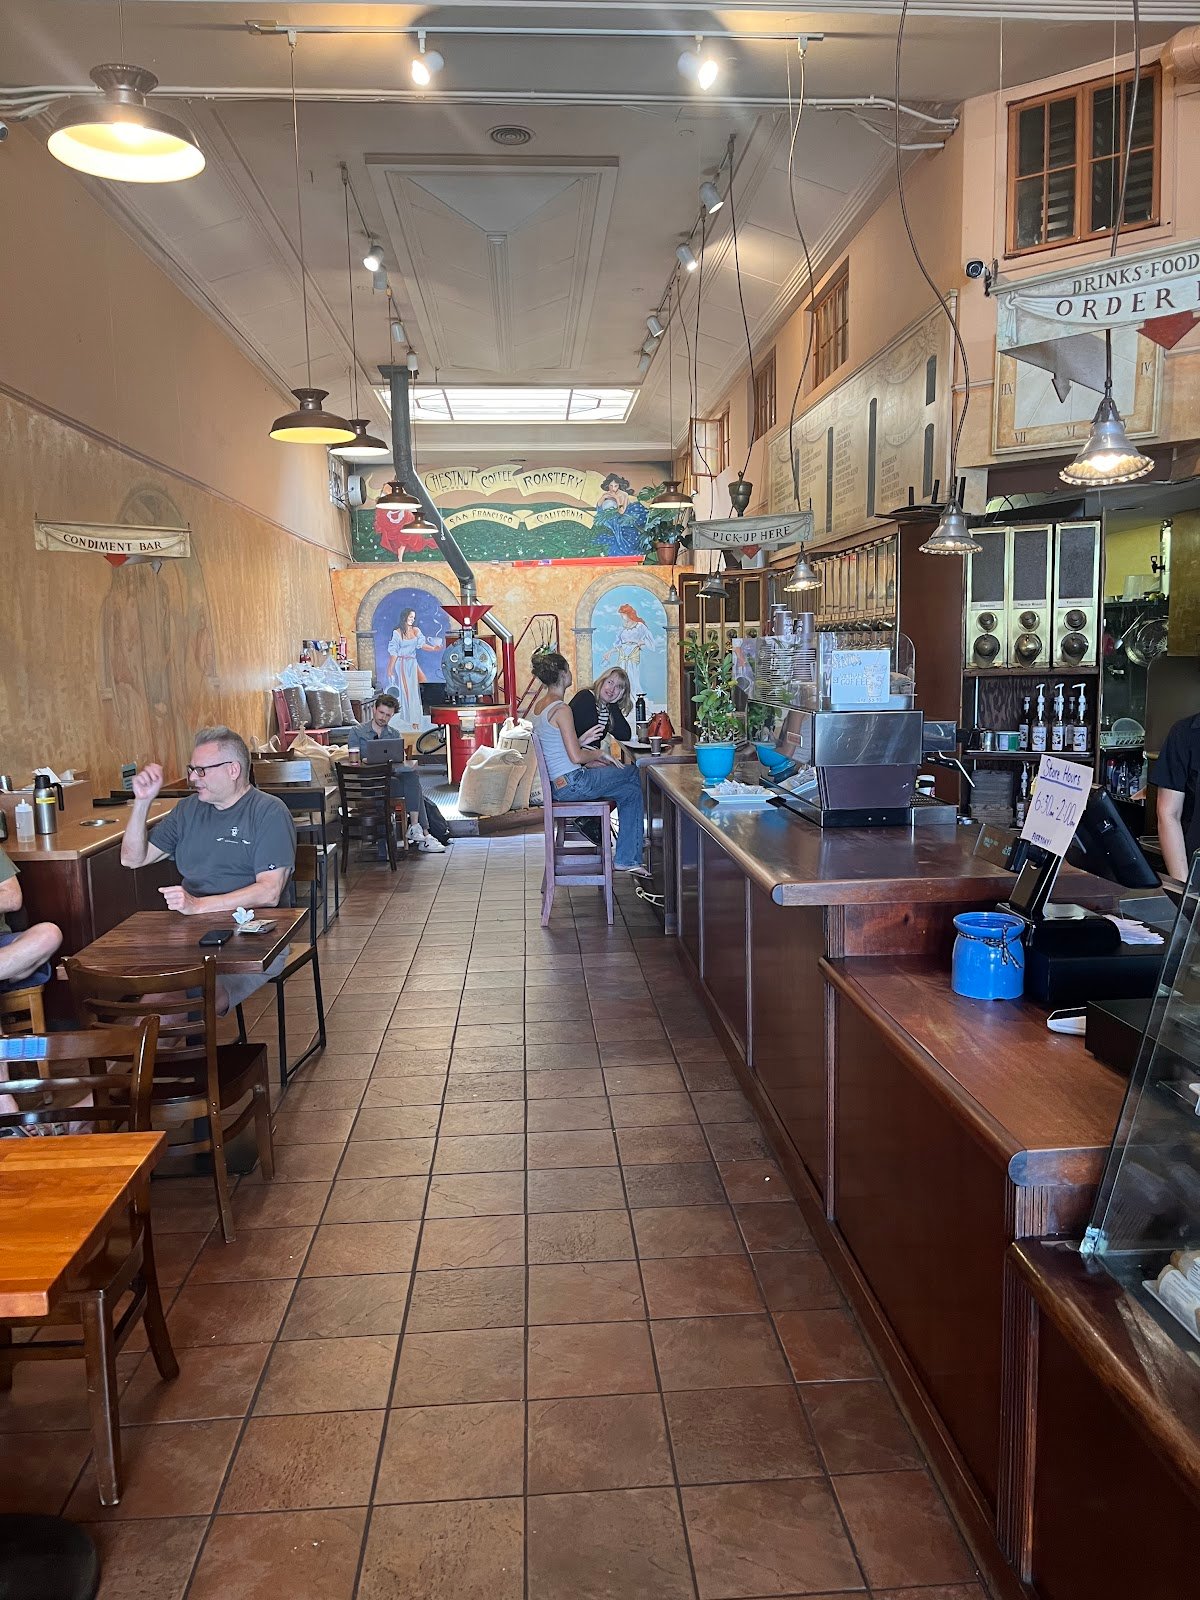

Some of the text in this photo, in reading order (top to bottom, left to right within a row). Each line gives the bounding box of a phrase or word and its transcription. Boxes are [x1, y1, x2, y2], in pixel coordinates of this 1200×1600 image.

[1072, 253, 1200, 295] DRINKS FOOD
[1056, 288, 1176, 320] ORDER
[424, 470, 583, 493] CHESTNUT COFFEE ROASTERY
[450, 510, 583, 525] SAN FRANCISCO CALIFORNIA
[63, 534, 162, 551] CONDIMENT BAR
[713, 526, 791, 543] PICK-UP HERE
[1044, 758, 1081, 786] Store Hours
